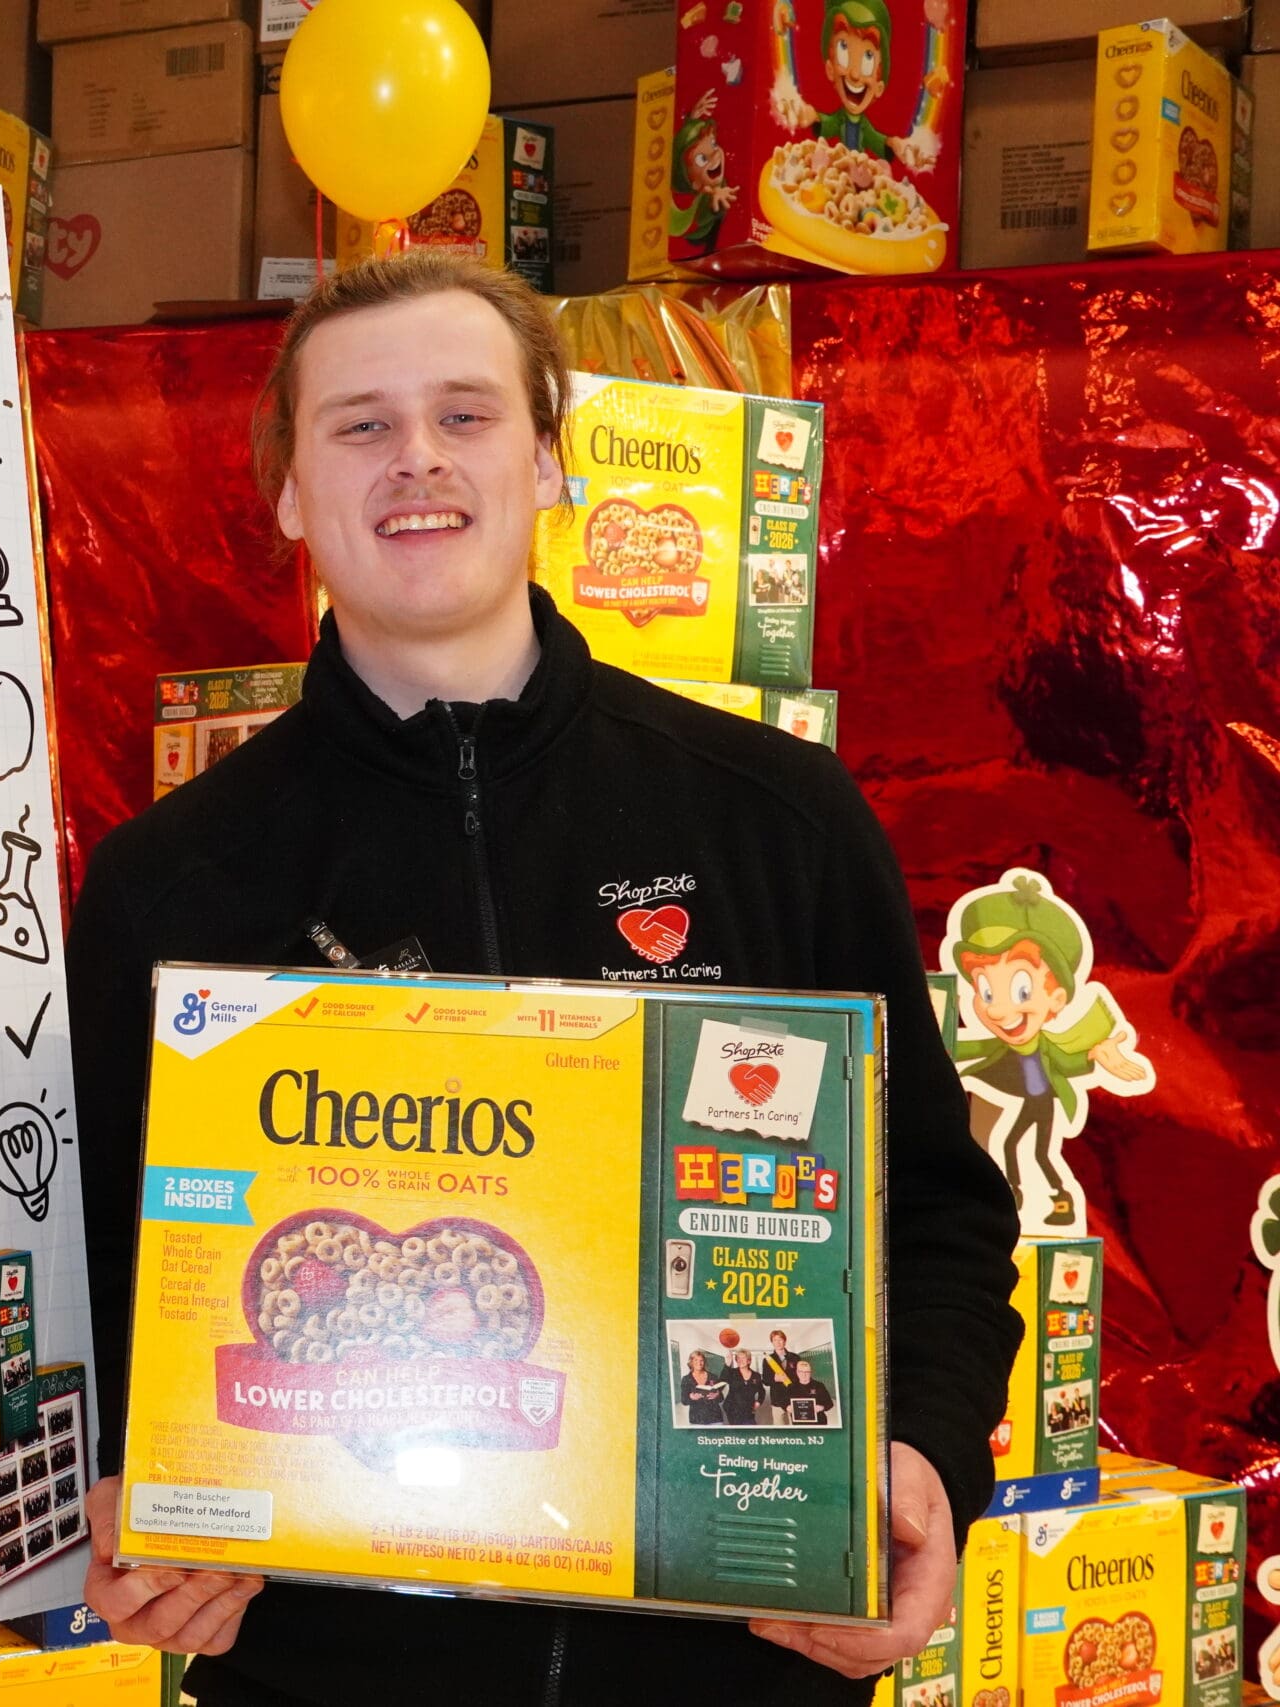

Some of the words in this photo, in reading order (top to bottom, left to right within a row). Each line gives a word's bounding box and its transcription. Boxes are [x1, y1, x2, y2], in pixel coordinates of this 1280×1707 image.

[47, 221, 93, 268] ty
[590, 425, 701, 475] Cheerios
[766, 519, 787, 531] CLASS
[769, 531, 794, 550] 2026
[621, 578, 639, 587] CAN
[641, 576, 663, 585] HELP
[580, 584, 617, 599] LOWER
[619, 585, 689, 598] CHOLESTEROL
[757, 622, 796, 643] Together
[598, 873, 697, 909] ShopRite
[602, 966, 658, 982] Partners
[662, 967, 676, 980] In
[681, 965, 722, 981] Caring
[211, 1002, 257, 1013] General
[322, 1002, 344, 1010] GOOD
[345, 1003, 375, 1011] SOURCE
[457, 1009, 487, 1017] SOURCE
[211, 1013, 237, 1023] Mills
[538, 1009, 555, 1032] 11
[559, 1014, 596, 1022] VITAMINS
[559, 1021, 598, 1029] MINERALS
[545, 1052, 590, 1069] Gluten
[593, 1055, 620, 1070] Free
[720, 1042, 785, 1062] ShopRite
[258, 1068, 536, 1158] Cheerios
[707, 1106, 750, 1120] Partners
[753, 1109, 765, 1121] In
[767, 1110, 800, 1126] Caring
[307, 1166, 380, 1189] 100%
[437, 1173, 508, 1196] OATS
[387, 1169, 431, 1181] WHOLE
[677, 1152, 835, 1205] HEROES
[165, 1177, 176, 1190] 2
[179, 1178, 235, 1194] BOXES
[387, 1180, 431, 1191] GRAIN
[164, 1192, 233, 1210] INSIDE!
[690, 1212, 749, 1235] ENDING
[756, 1216, 822, 1239] HUNGER
[164, 1230, 202, 1244] Toasted
[163, 1245, 192, 1259] Whole
[195, 1247, 221, 1260] Grain
[712, 1246, 770, 1270] CLASS
[775, 1249, 799, 1272] OF
[162, 1259, 179, 1272] Oat
[181, 1261, 212, 1274] Cereal
[160, 1277, 192, 1290] Cereal
[194, 1280, 206, 1292] de
[722, 1270, 790, 1308] 2026
[159, 1292, 189, 1306] Avena
[191, 1294, 229, 1310] Integral
[159, 1306, 198, 1321] Tostado
[336, 1369, 378, 1386] CAN
[386, 1365, 441, 1384] HELP
[234, 1381, 326, 1411] LOWER
[330, 1385, 512, 1411] CHOLESTEROL
[292, 1414, 306, 1428] AS
[309, 1414, 337, 1430] PART
[697, 1436, 746, 1448] ShopRite
[748, 1436, 759, 1446] of
[761, 1436, 806, 1447] Newton,
[808, 1436, 825, 1446] NJ
[718, 1454, 758, 1472] Ending
[763, 1457, 809, 1474] Hunger
[148, 1473, 162, 1482] PER
[179, 1475, 194, 1484] CUP
[700, 1464, 809, 1511] Together
[173, 1491, 194, 1501] Ryan
[196, 1492, 231, 1502] Buscher
[152, 1503, 195, 1516] ShopRite
[197, 1506, 207, 1516] of
[209, 1507, 251, 1519] Medford
[135, 1517, 167, 1528] ShopRite
[170, 1519, 200, 1529] Partners
[210, 1522, 234, 1533] Caring
[236, 1524, 267, 1534] 2025-26
[426, 1529, 440, 1540] OZ
[462, 1532, 481, 1545] OZ)
[484, 1532, 517, 1549] (510g)
[521, 1536, 613, 1555] CARTONS/CAJAS
[371, 1540, 391, 1553] NET
[396, 1542, 445, 1559] WT/PESO
[447, 1546, 476, 1562] NETO
[479, 1549, 486, 1562] 2
[489, 1550, 503, 1564] LB
[506, 1551, 513, 1564] 4
[516, 1552, 530, 1566] OZ
[533, 1553, 551, 1570] (36
[554, 1555, 572, 1572] OZ)
[575, 1557, 613, 1576] (1.0kg)
[1067, 1553, 1155, 1592] Cheerios
[980, 1569, 1004, 1680] Cheerios
[920, 1659, 943, 1677] 2026
[1092, 1680, 1149, 1705] CHOLESTEROL
